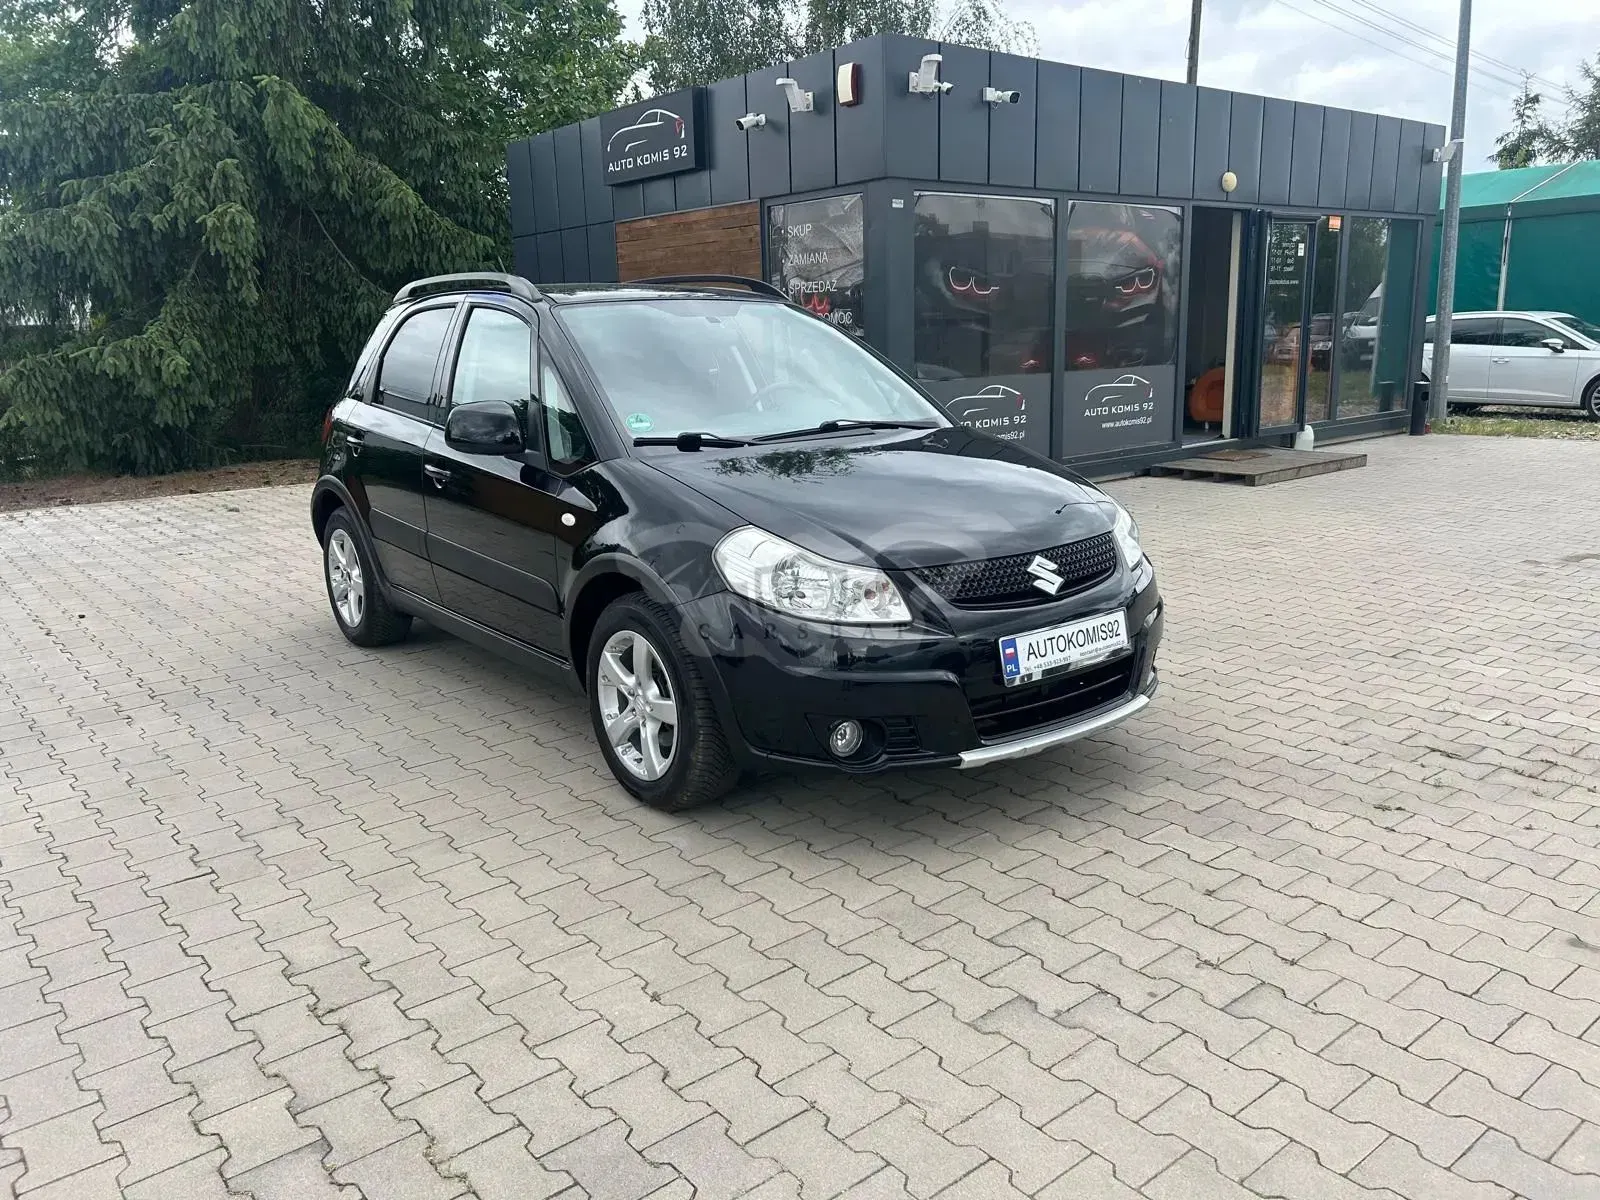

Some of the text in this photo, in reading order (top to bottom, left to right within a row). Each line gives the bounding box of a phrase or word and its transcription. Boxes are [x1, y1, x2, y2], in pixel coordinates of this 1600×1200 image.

[607, 144, 688, 173] AUTO KOMIS 92
[787, 223, 812, 238] SKUP
[788, 251, 829, 266] ZAMIANA
[1083, 402, 1154, 417] AUTO KOMIS 92
[975, 416, 1010, 429] KOMIS
[1013, 414, 1027, 424] 92
[1026, 619, 1121, 662] AUTOKOMIS92
[1006, 664, 1019, 673] PL
